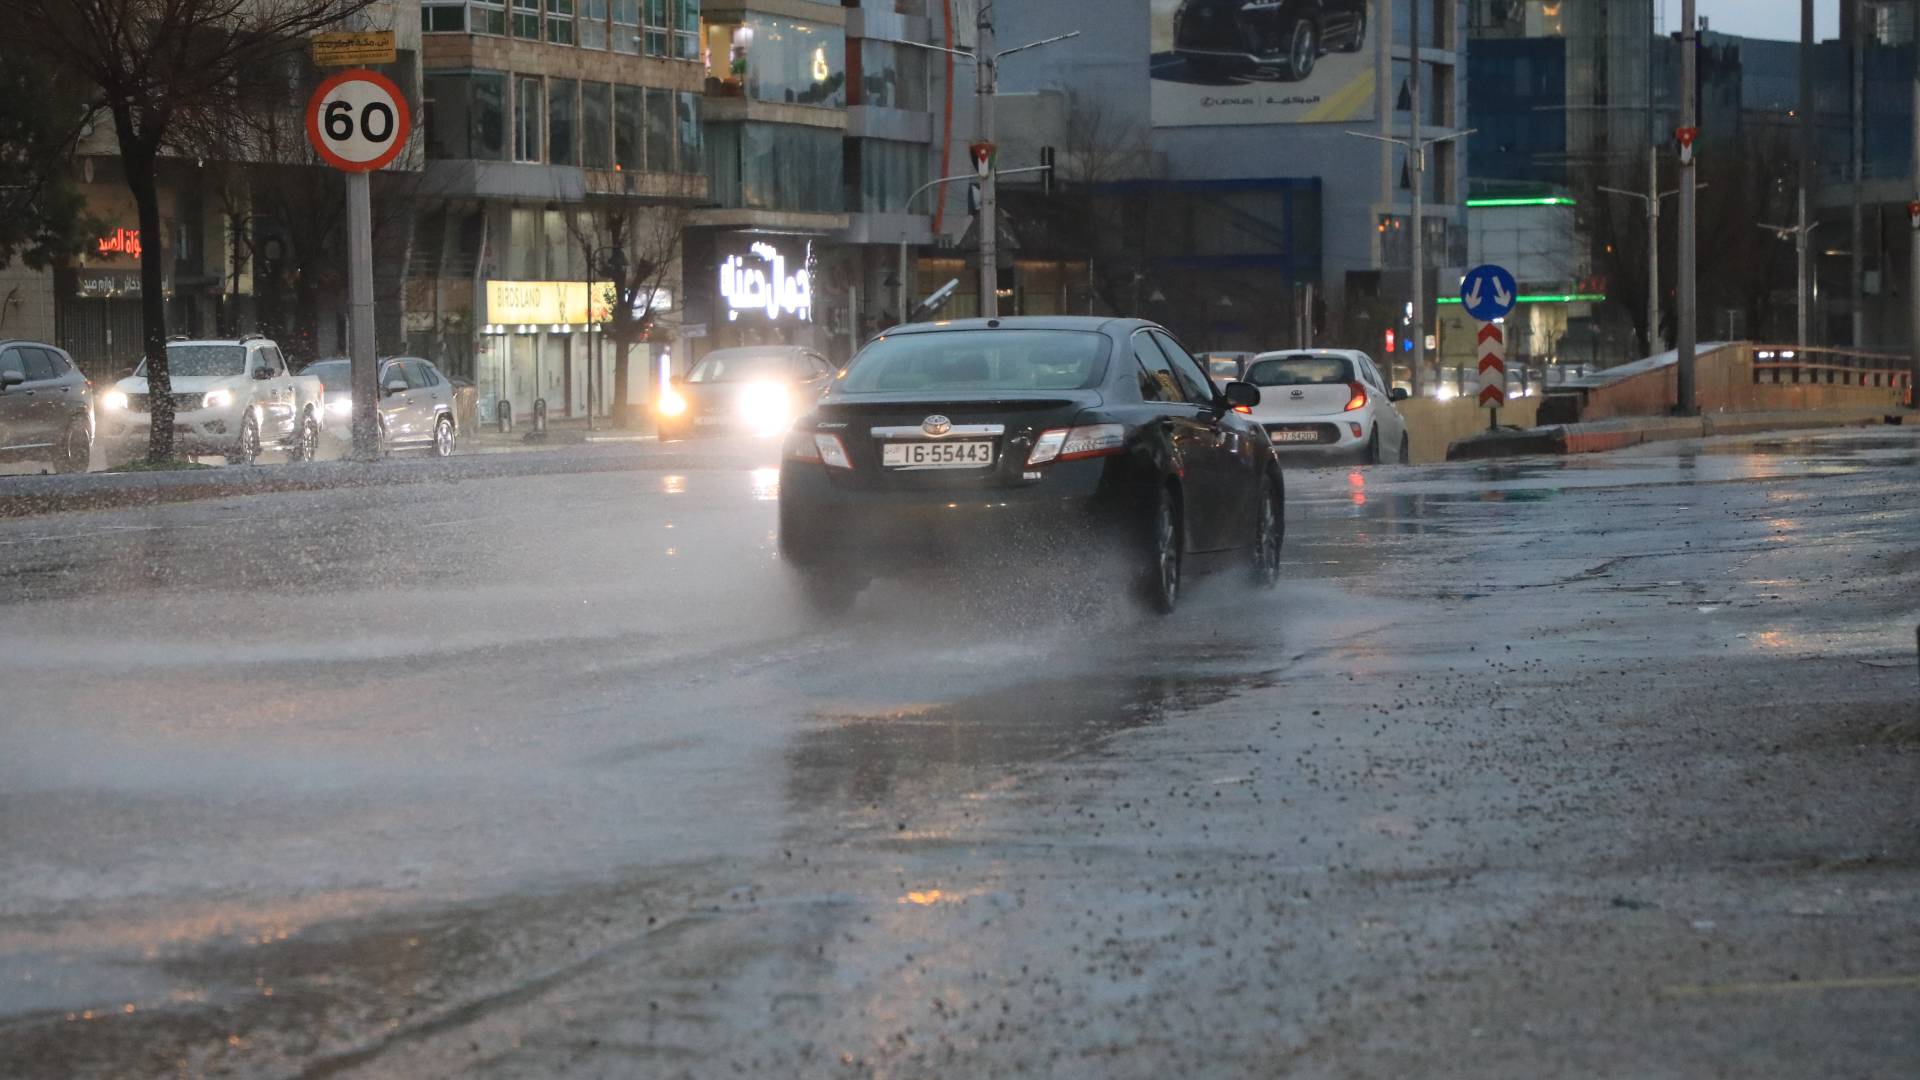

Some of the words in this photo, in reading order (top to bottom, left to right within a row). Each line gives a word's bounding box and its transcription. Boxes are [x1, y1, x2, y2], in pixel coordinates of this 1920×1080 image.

[324, 100, 394, 143] 60
[99, 228, 124, 256] الصيد
[905, 444, 990, 464] 16-55443
